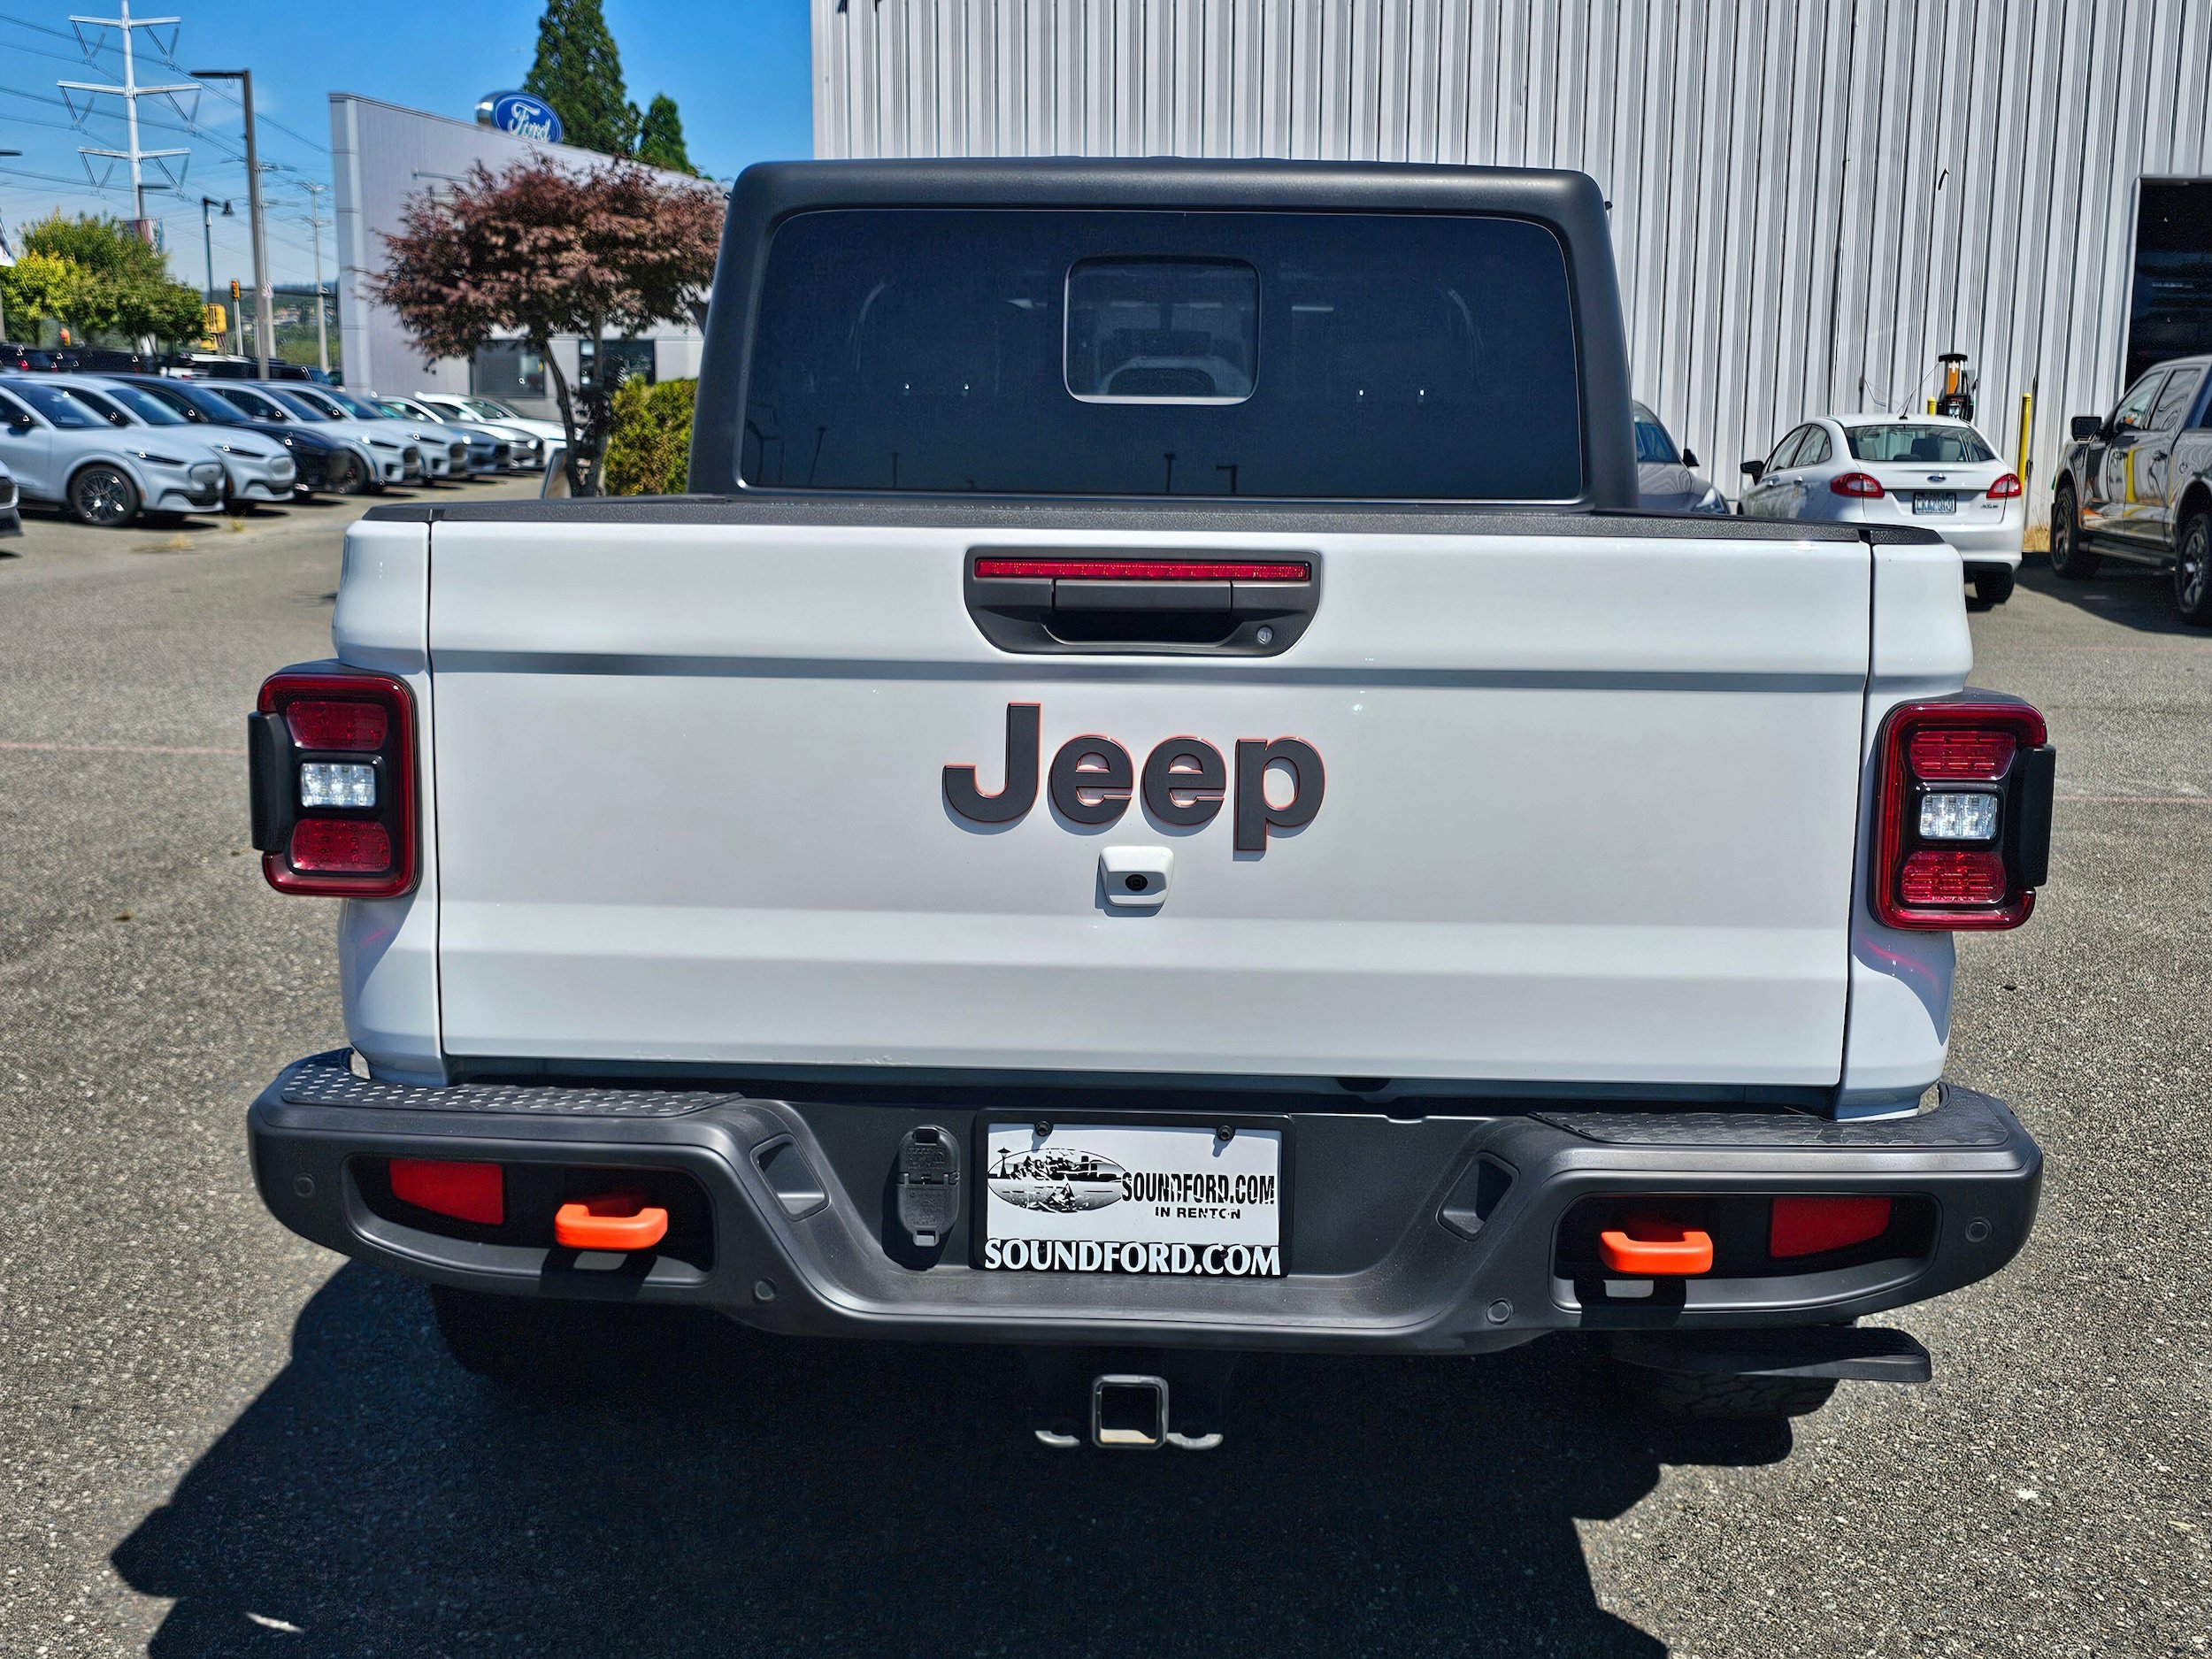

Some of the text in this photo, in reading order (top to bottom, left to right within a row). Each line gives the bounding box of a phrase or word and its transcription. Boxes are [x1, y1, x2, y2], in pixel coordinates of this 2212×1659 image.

[508, 103, 551, 142] Ford
[942, 702, 1325, 851] Jeep
[1121, 1171, 1275, 1204] SOUNDFORD.COM
[1155, 1206, 1171, 1218] IN
[984, 1238, 1281, 1276] SOUNDFORD.COM
